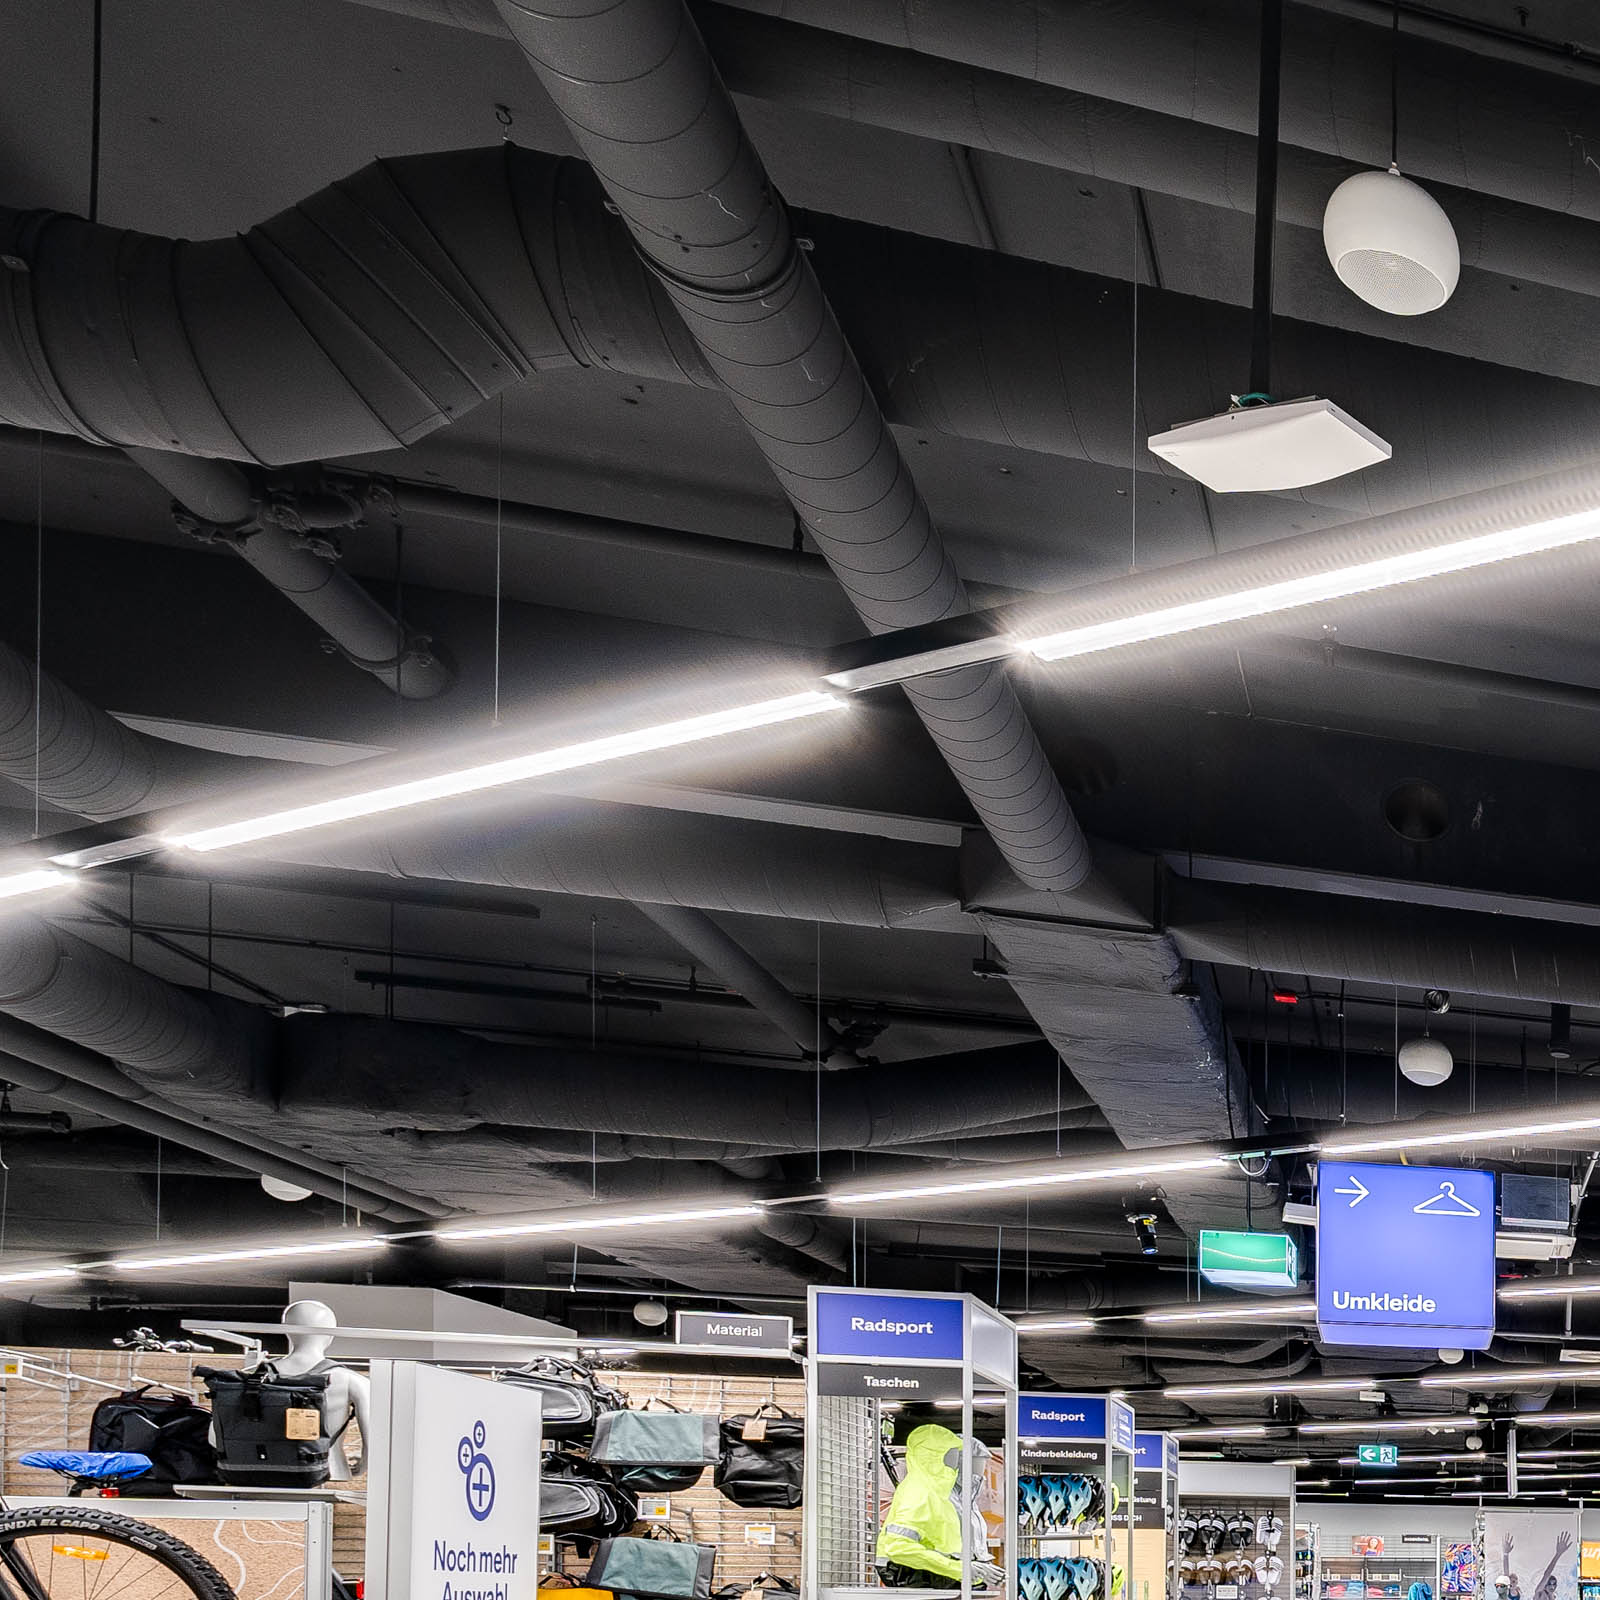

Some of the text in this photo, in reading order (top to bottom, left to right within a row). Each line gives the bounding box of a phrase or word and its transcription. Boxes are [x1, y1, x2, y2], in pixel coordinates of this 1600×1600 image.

[1333, 1290, 1437, 1313] Umkleide
[706, 1322, 763, 1338] Material
[850, 1317, 934, 1337] Radsport
[863, 1375, 920, 1389] Taschen
[1031, 1410, 1085, 1423] Radsport
[1021, 1449, 1098, 1460] Kinderbekleidung
[433, 1539, 518, 1574] Noch mehr
